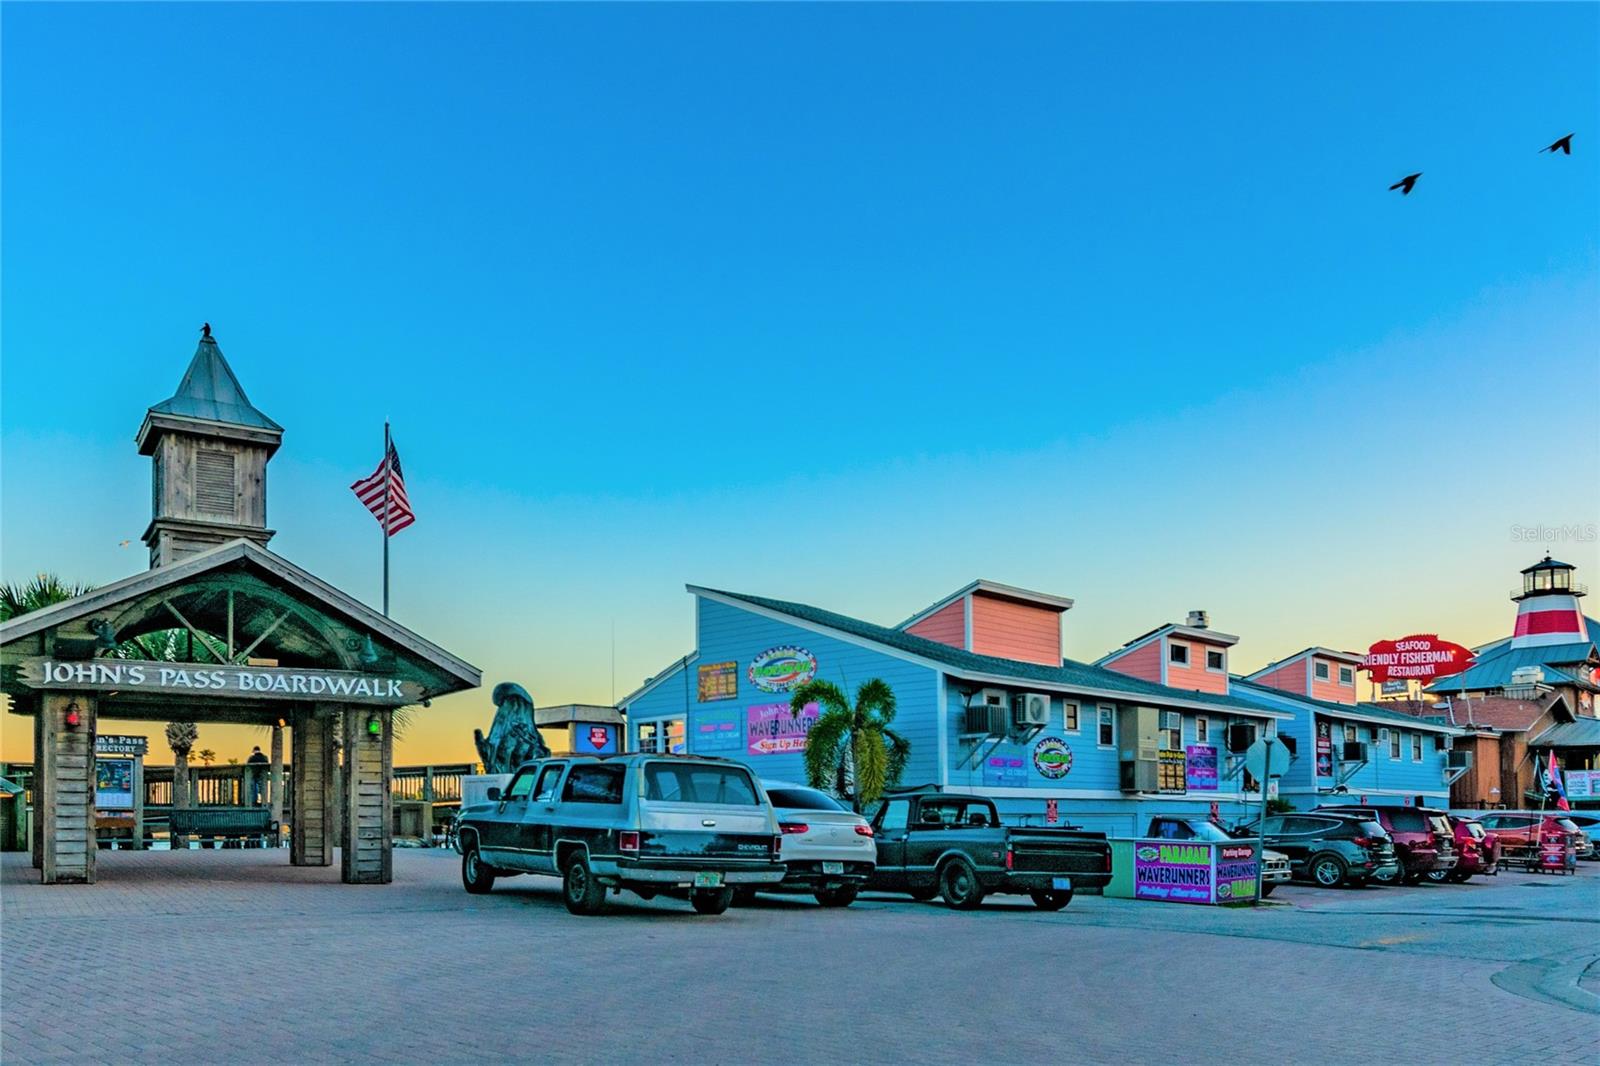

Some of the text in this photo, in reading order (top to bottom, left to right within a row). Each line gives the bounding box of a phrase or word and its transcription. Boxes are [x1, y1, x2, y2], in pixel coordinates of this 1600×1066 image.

[1395, 641, 1430, 651] SEAFOOD
[1360, 651, 1453, 666] RIENDLY FISHERMAN
[1387, 664, 1435, 676] RESTAURANT
[43, 661, 403, 697] JOHN'S PASS BOARDWALK
[119, 736, 144, 744] Pass
[1137, 866, 1210, 886] WAVERUNNERS
